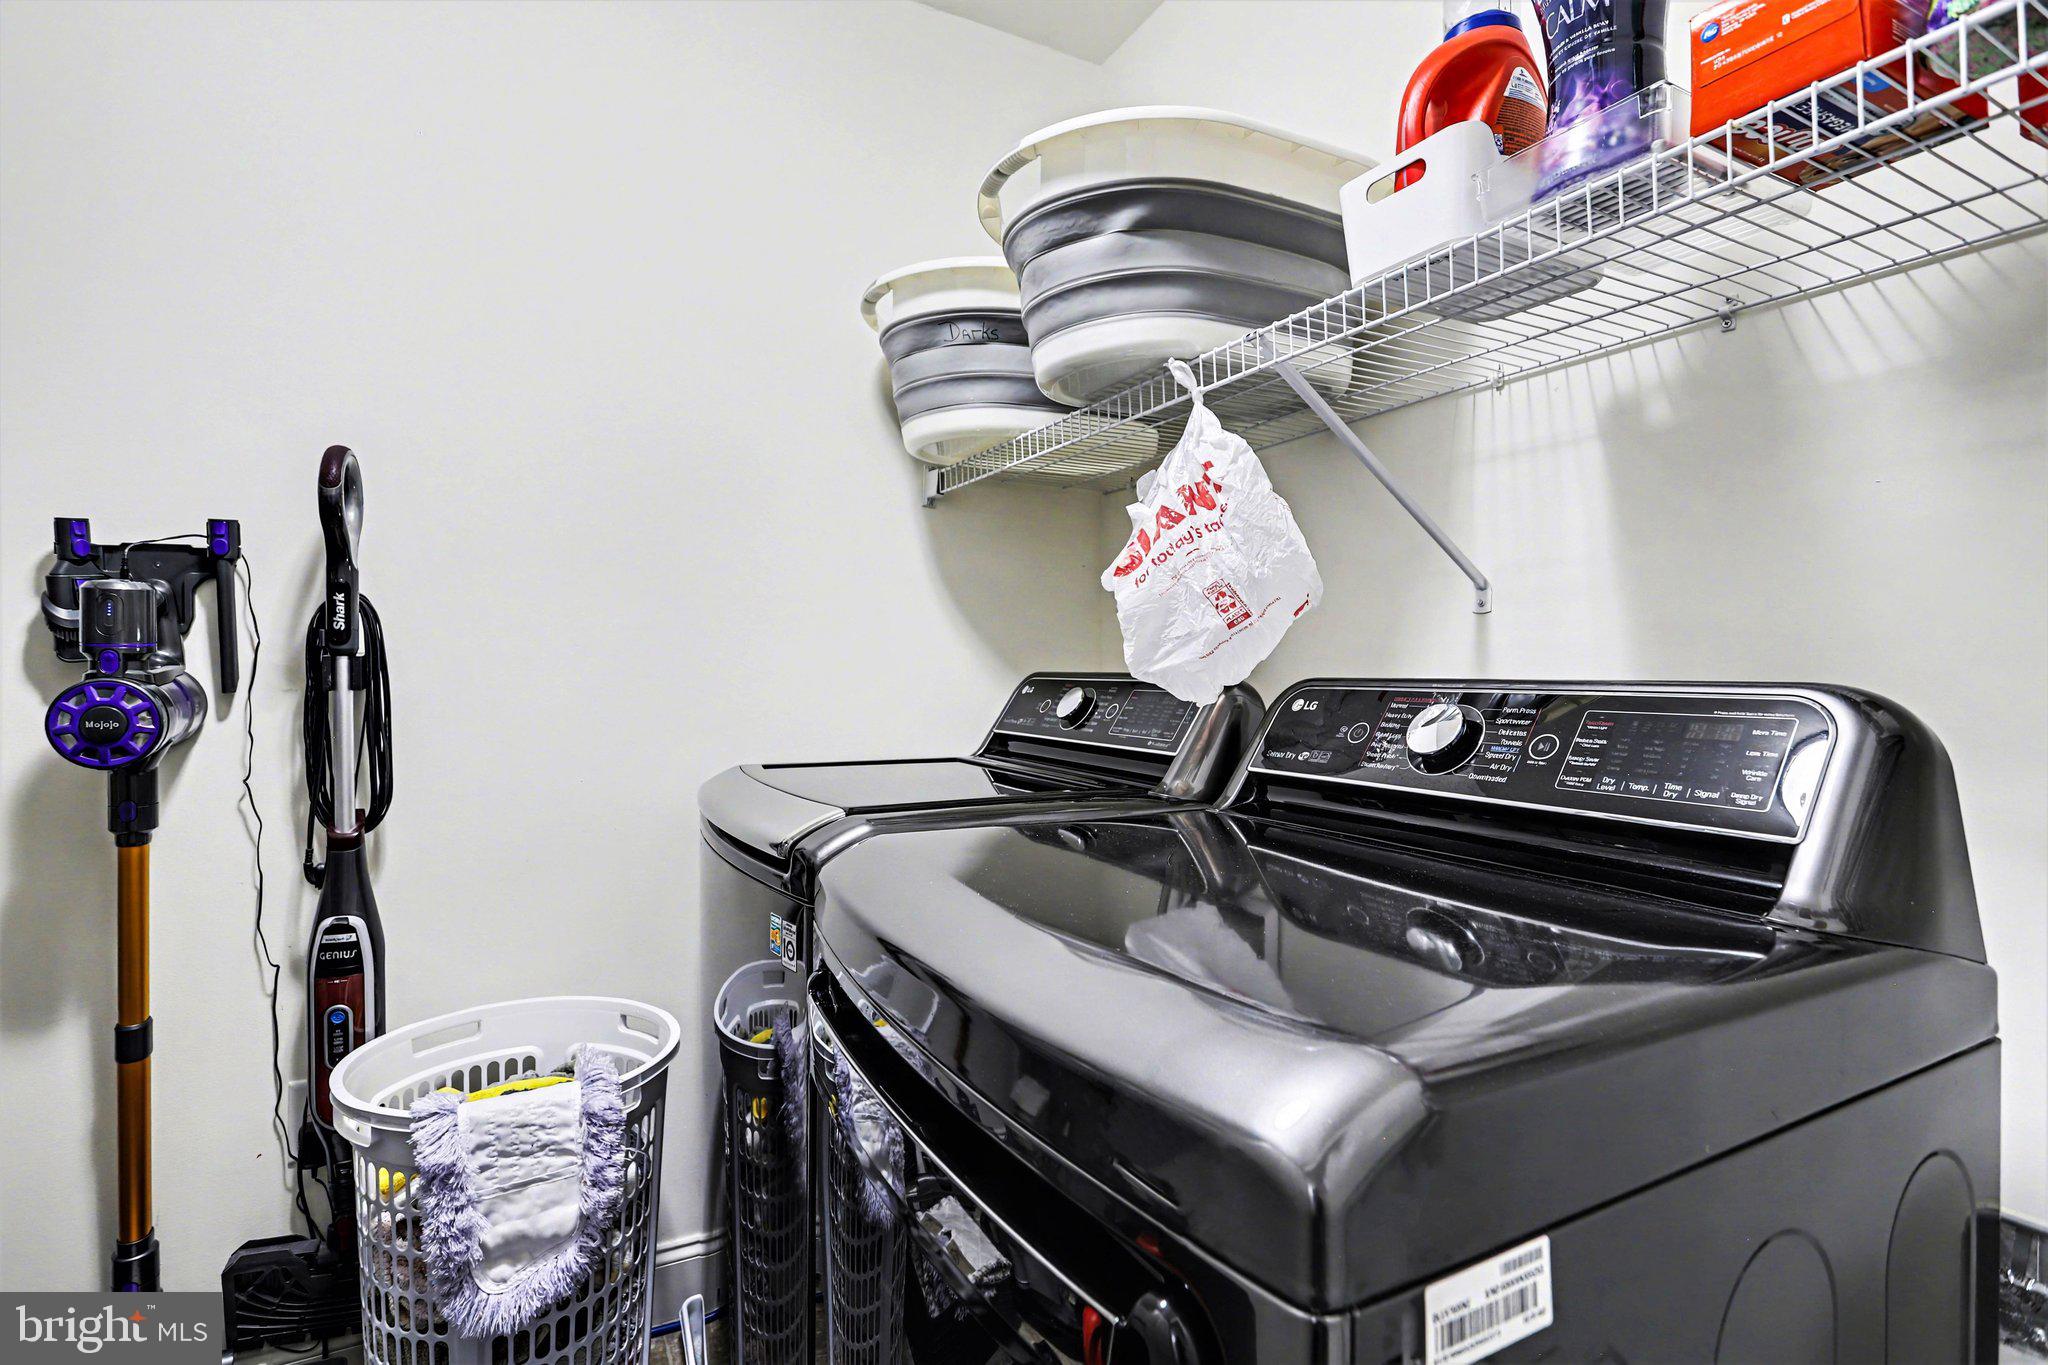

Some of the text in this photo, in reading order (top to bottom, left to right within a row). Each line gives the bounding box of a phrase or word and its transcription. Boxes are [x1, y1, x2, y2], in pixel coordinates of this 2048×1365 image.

[938, 320, 1000, 342] Darks
[1134, 566, 1150, 588] for
[1151, 525, 1203, 568] today's
[333, 591, 346, 630] Shark
[85, 720, 120, 730] Mojojo
[1500, 739, 1523, 747] Towels
[1285, 751, 1297, 760] Dry
[1485, 751, 1517, 761] Speed Dry
[1500, 764, 1512, 772] Dry
[1741, 769, 1768, 777] Wrinkle
[1468, 772, 1508, 783] Downloaded
[1602, 776, 1615, 785] Dry
[1628, 782, 1650, 792] Temp.
[1664, 782, 1683, 791] Time
[1663, 790, 1679, 800] Dry
[1694, 789, 1720, 799] Signal
[1750, 794, 1764, 802] Dry
[319, 949, 358, 960] GENIUS
